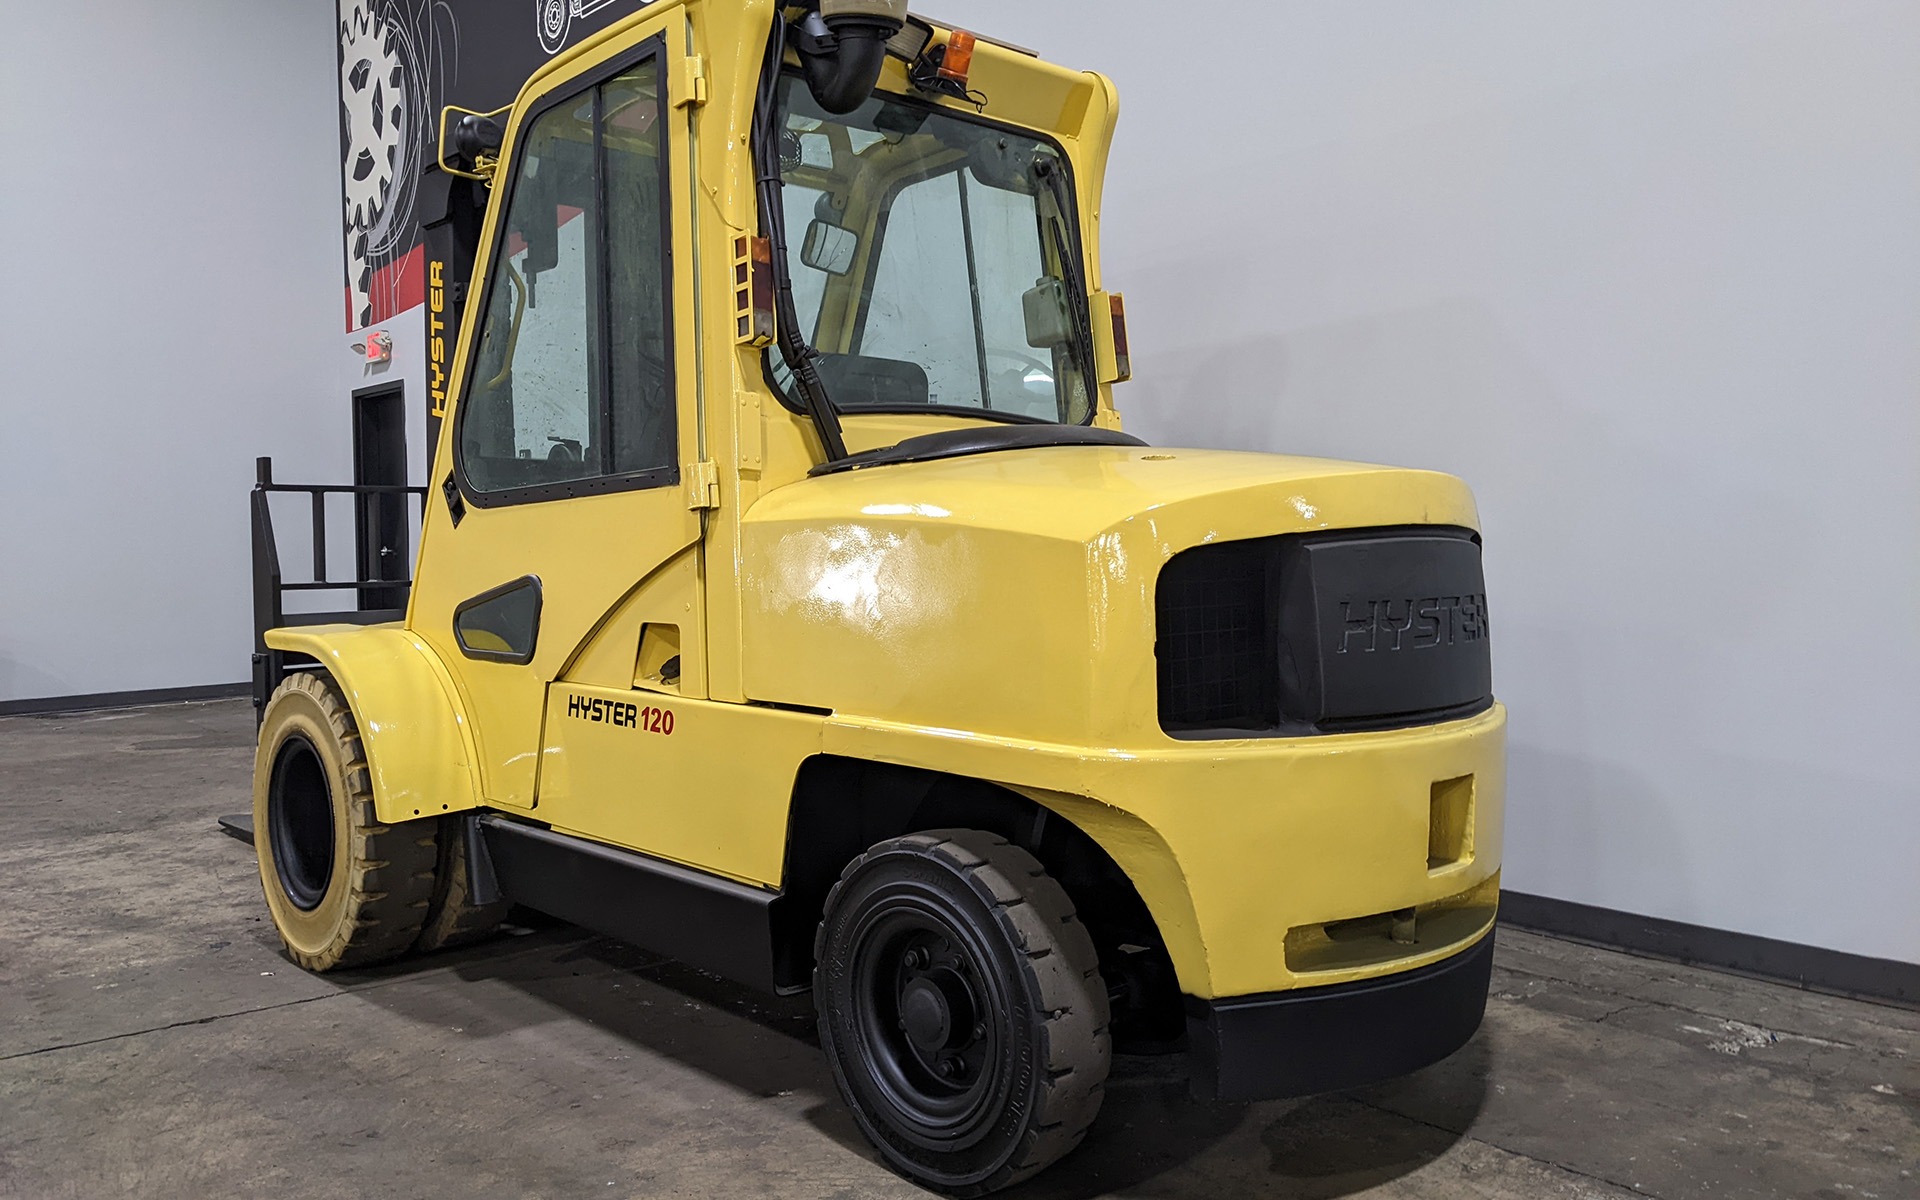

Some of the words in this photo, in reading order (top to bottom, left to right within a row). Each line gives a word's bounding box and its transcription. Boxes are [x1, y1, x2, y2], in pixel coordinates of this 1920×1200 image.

[430, 260, 445, 418] HYSTER
[1337, 593, 1488, 653] HYSTER
[567, 694, 637, 729] HYSTER
[641, 706, 674, 736] 120
